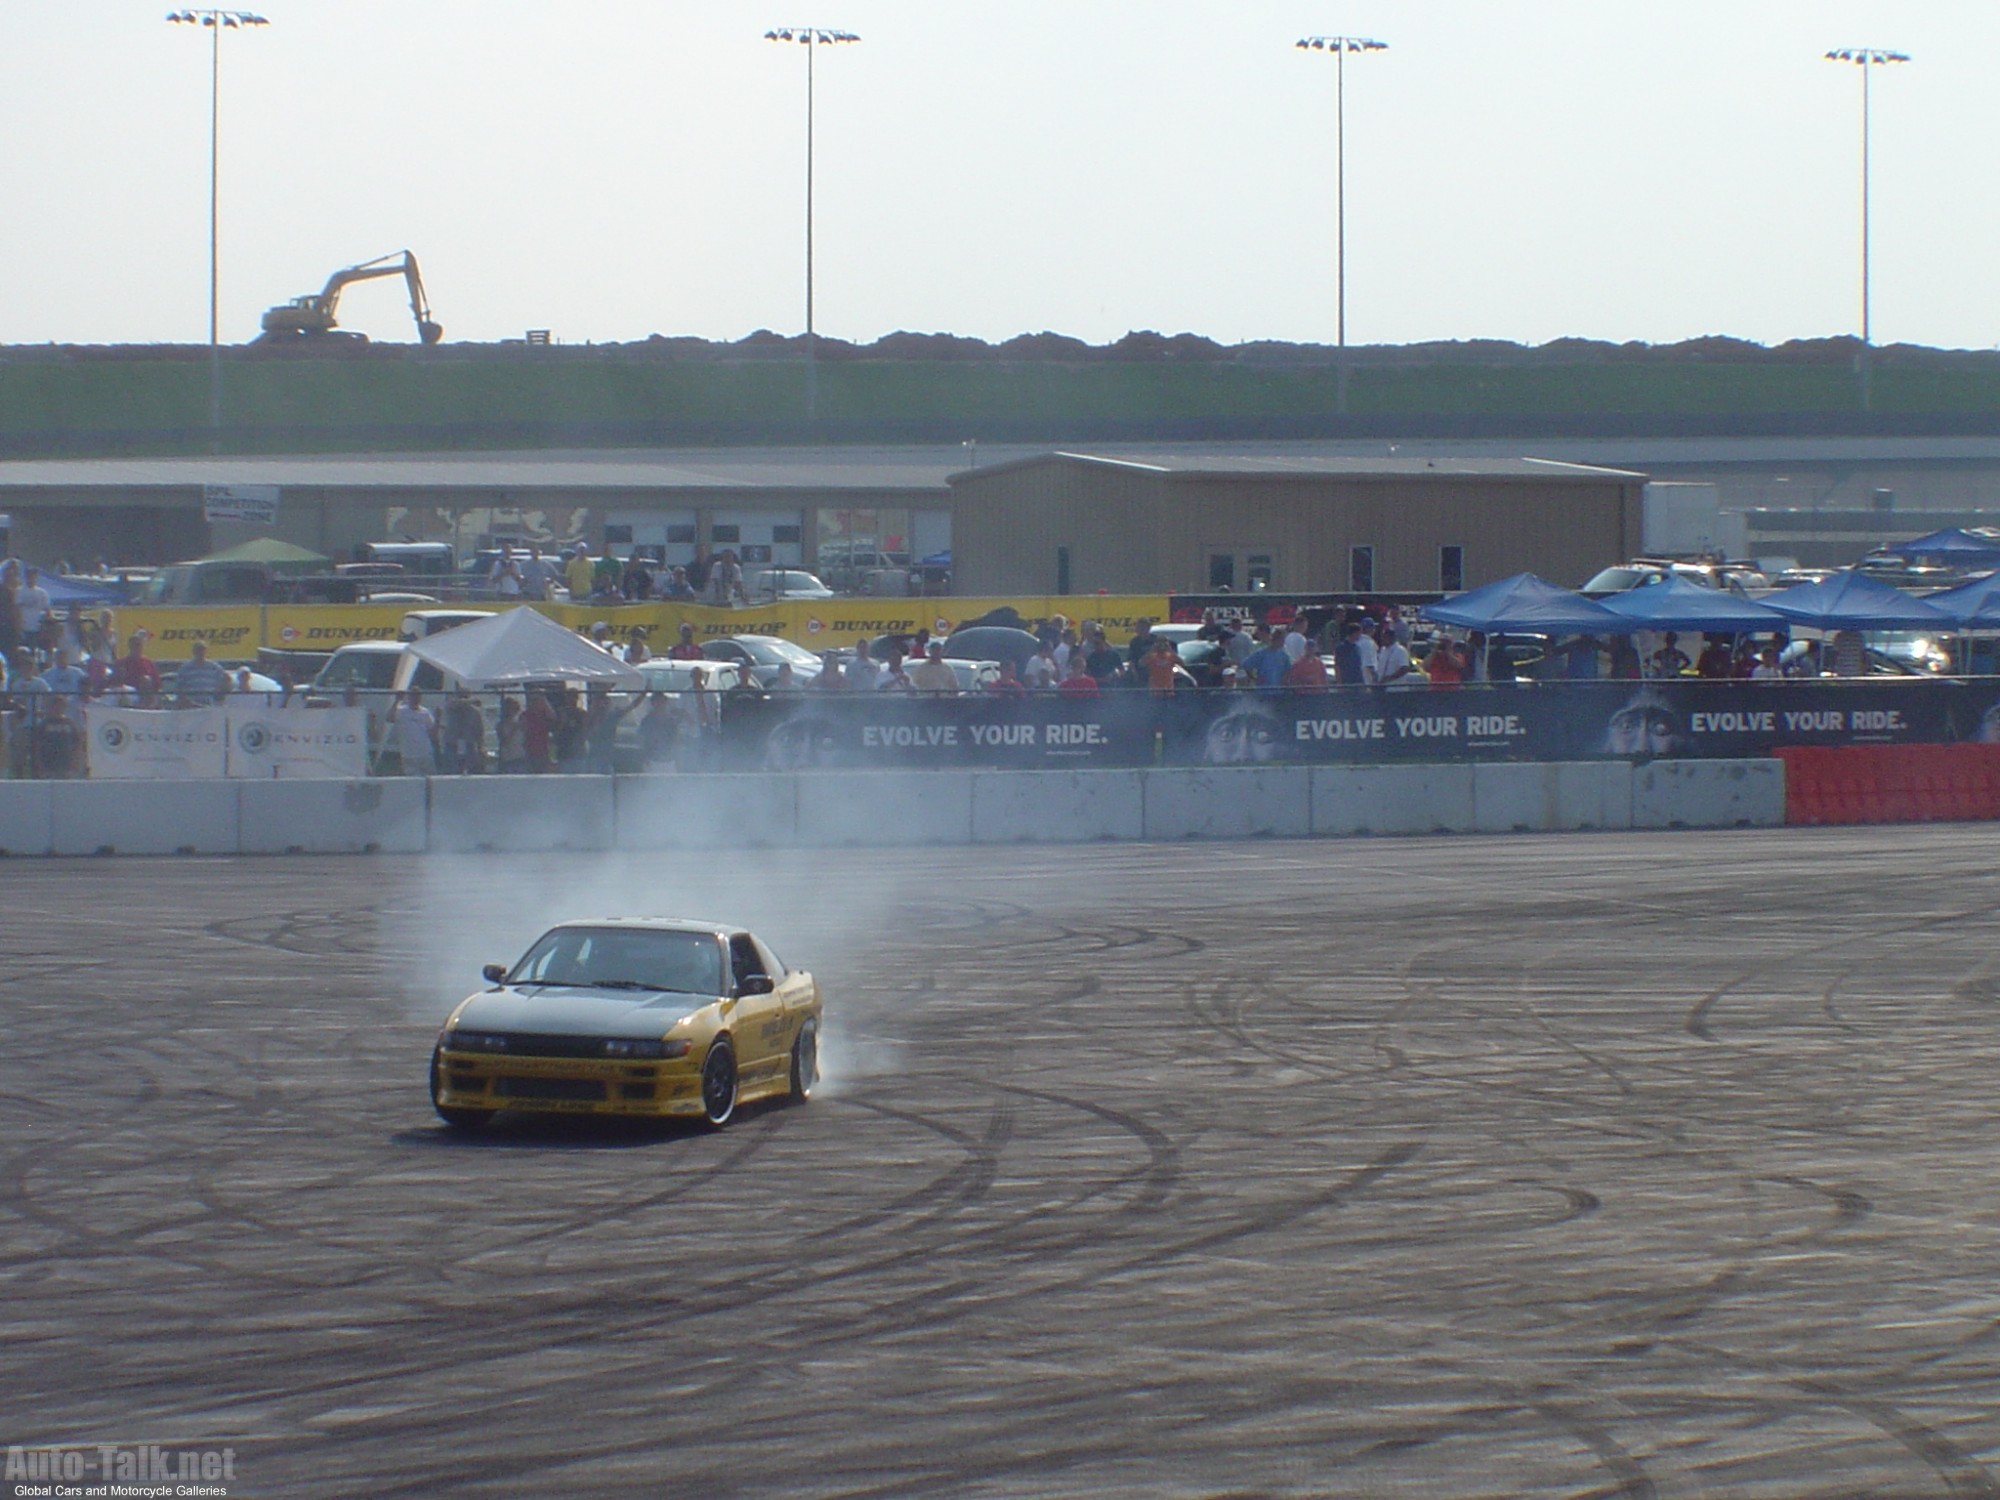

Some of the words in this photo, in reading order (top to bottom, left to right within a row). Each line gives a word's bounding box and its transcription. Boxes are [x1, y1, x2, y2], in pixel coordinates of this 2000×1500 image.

[703, 622, 787, 635] DUNLOP
[831, 620, 914, 632] DUNLOP
[160, 627, 250, 641] DUNLOP
[306, 627, 395, 639] DUNLOP
[1691, 712, 1775, 731] EVOLVE
[1784, 711, 1843, 730] YOUR
[1852, 710, 1908, 730] RIDE.
[1296, 719, 1385, 740] EVOLVE
[1395, 717, 1457, 737] YOUR
[1467, 716, 1526, 736] RIDE.
[134, 732, 217, 743] ENVIZIO
[275, 734, 357, 744] ENVIZIO
[863, 726, 958, 746] EVOLVE
[969, 725, 1035, 745] YOUR
[1046, 724, 1108, 744] RIDE.
